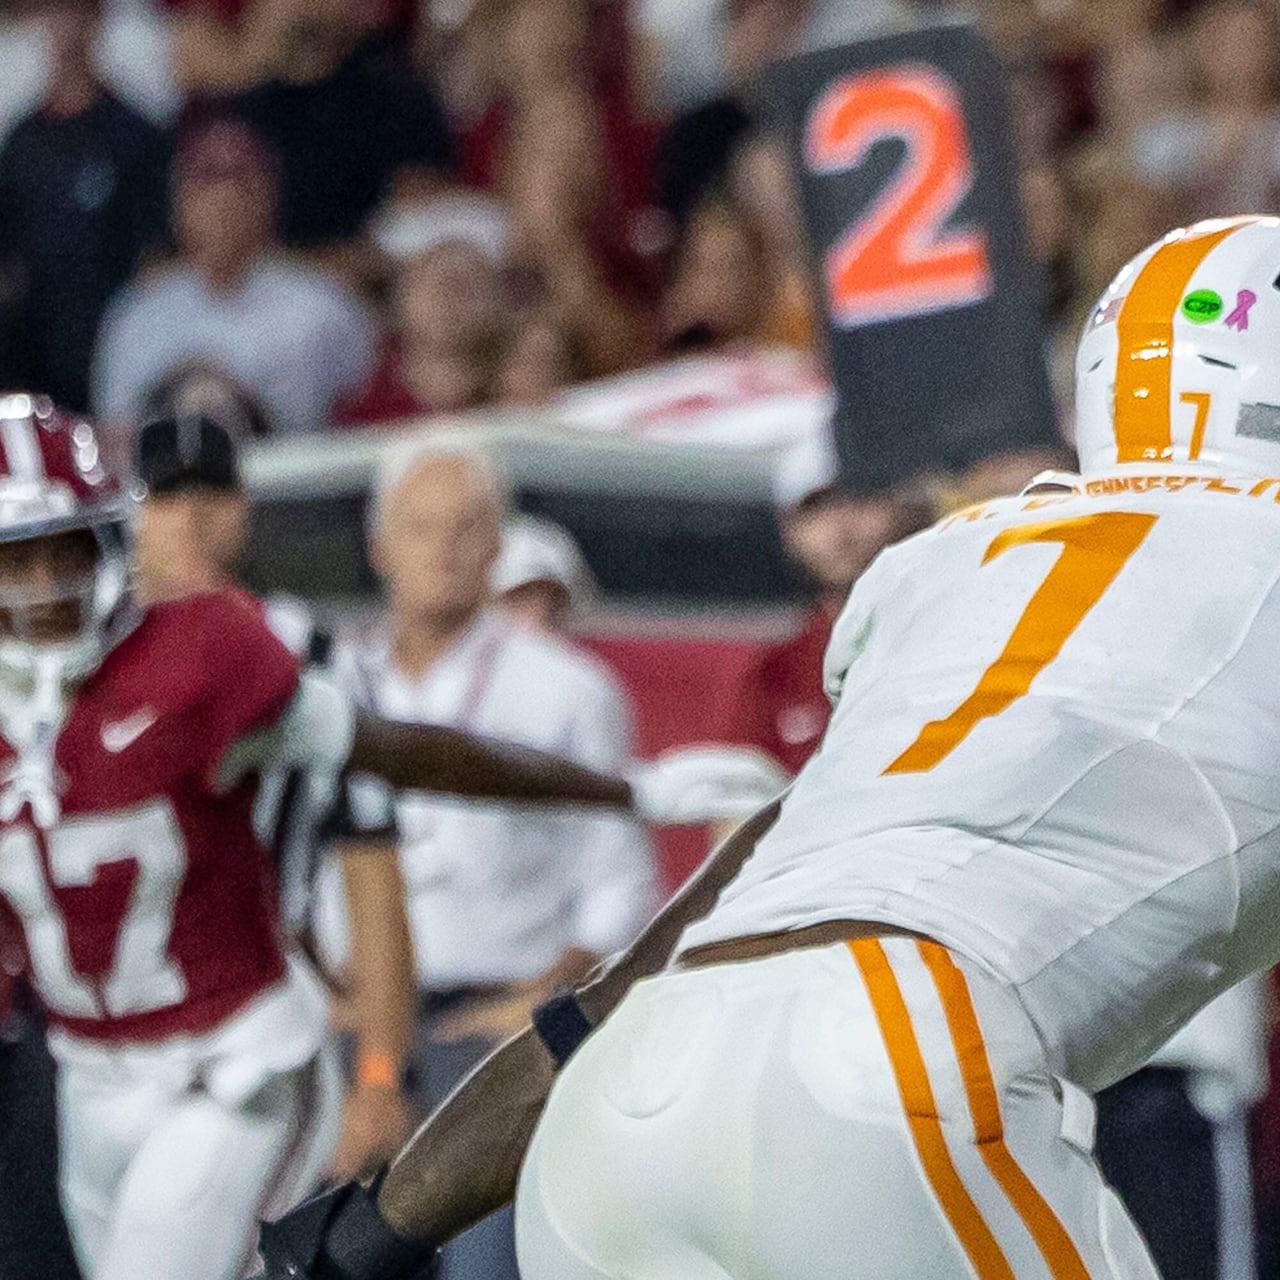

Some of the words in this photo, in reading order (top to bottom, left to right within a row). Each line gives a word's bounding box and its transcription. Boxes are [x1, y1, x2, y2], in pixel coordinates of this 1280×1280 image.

[804, 62, 990, 328] 2
[1179, 391, 1211, 460] 7
[879, 511, 1160, 776] 7
[0, 798, 189, 1021] 17
